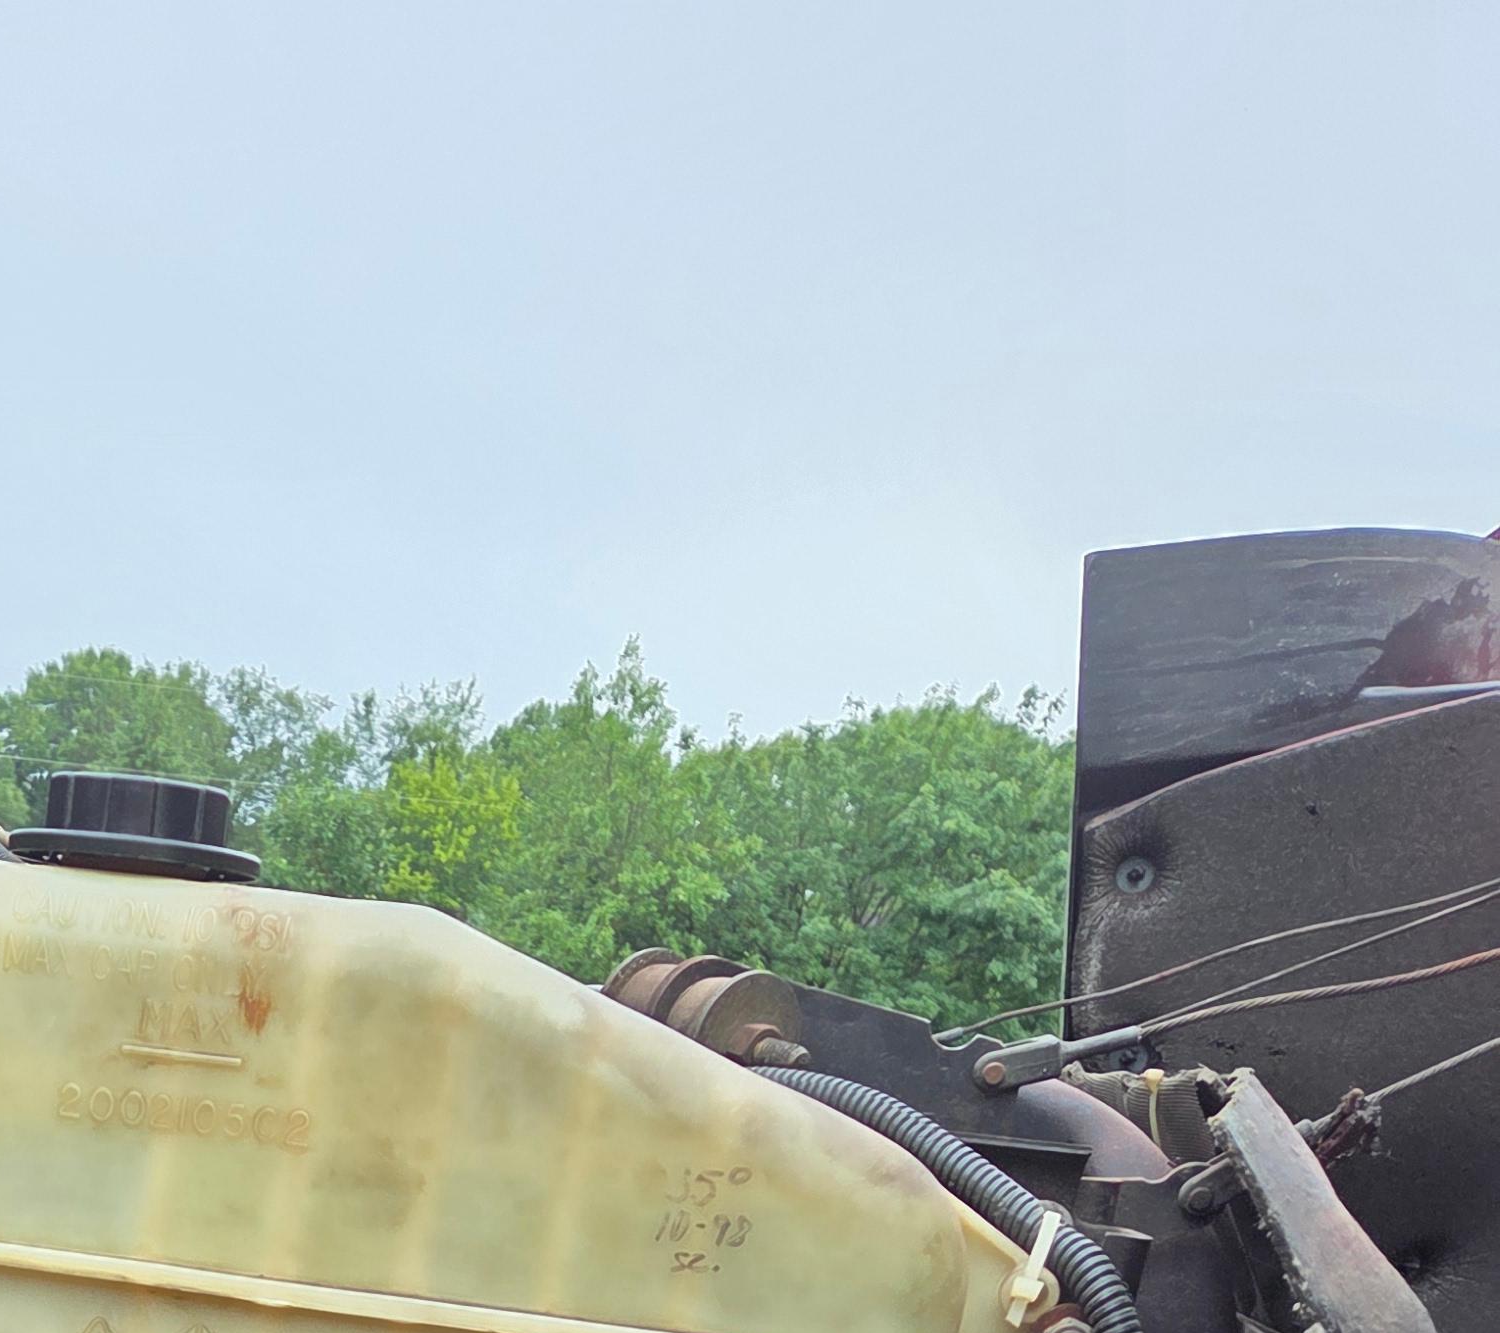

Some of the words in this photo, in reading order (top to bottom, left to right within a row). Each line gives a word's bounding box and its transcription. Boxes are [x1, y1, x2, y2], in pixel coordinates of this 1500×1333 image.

[182, 904, 217, 944] 10
[235, 905, 292, 953] PSI
[2, 930, 72, 976] MAX
[91, 944, 158, 985] CAP
[172, 953, 268, 1001] ONLY
[138, 998, 235, 1044] MAX
[58, 1081, 311, 1149] 2002105C2
